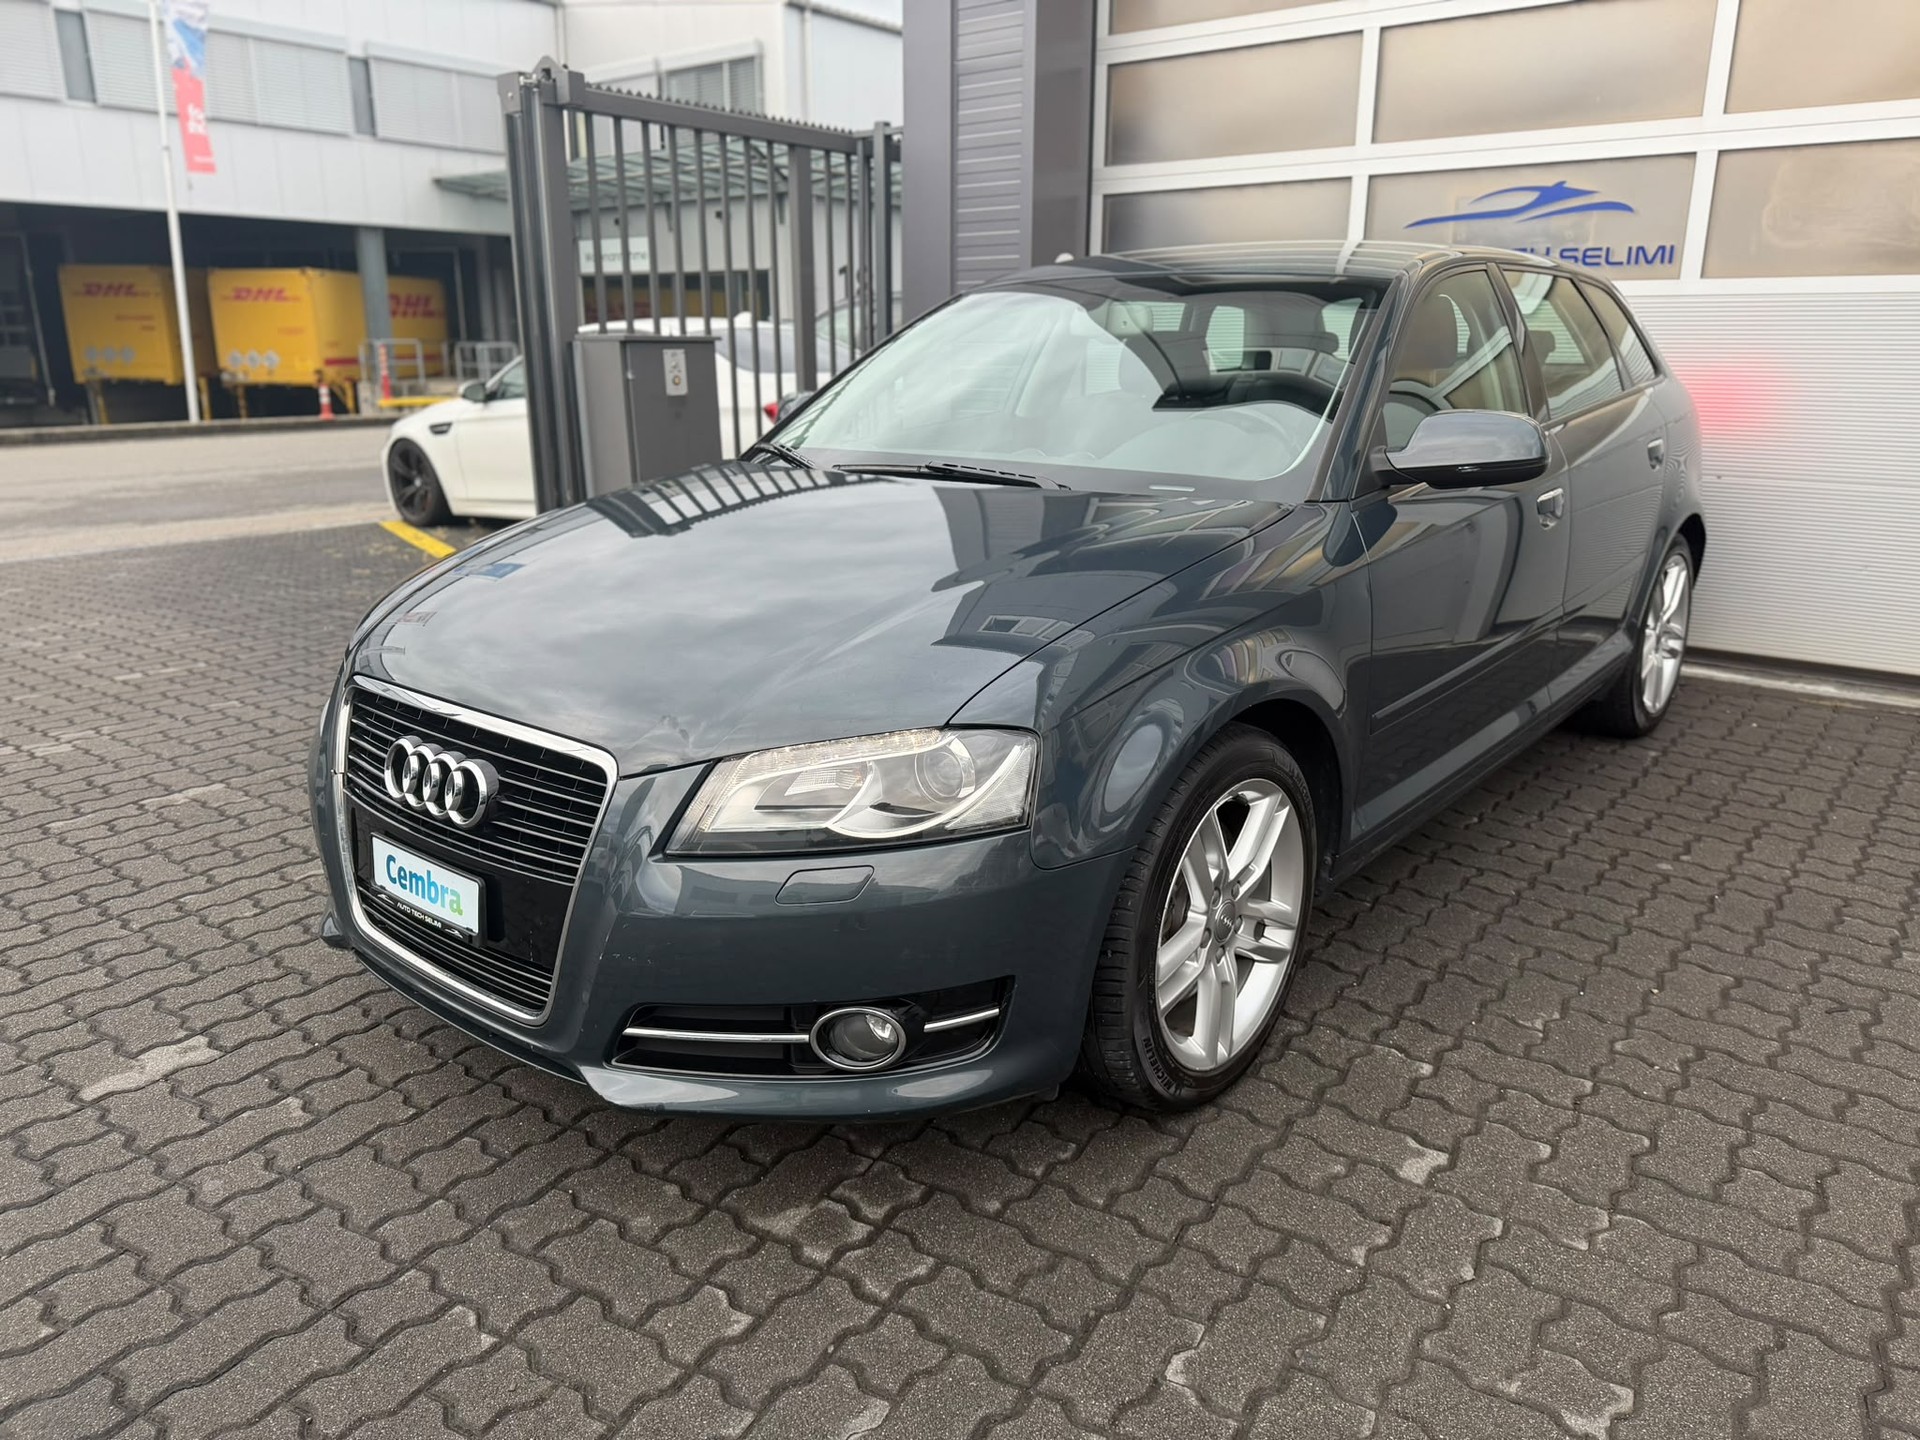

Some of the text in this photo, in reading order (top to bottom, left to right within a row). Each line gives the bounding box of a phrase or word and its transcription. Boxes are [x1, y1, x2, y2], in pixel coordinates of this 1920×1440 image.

[1559, 245, 1675, 267] SELIMI
[82, 281, 137, 297] DHL
[231, 286, 288, 303] DHL
[386, 854, 463, 916] Cembra
[396, 902, 411, 914] AUTO
[411, 909, 424, 920] TECH
[1142, 1036, 1175, 1091] MICHELIN
